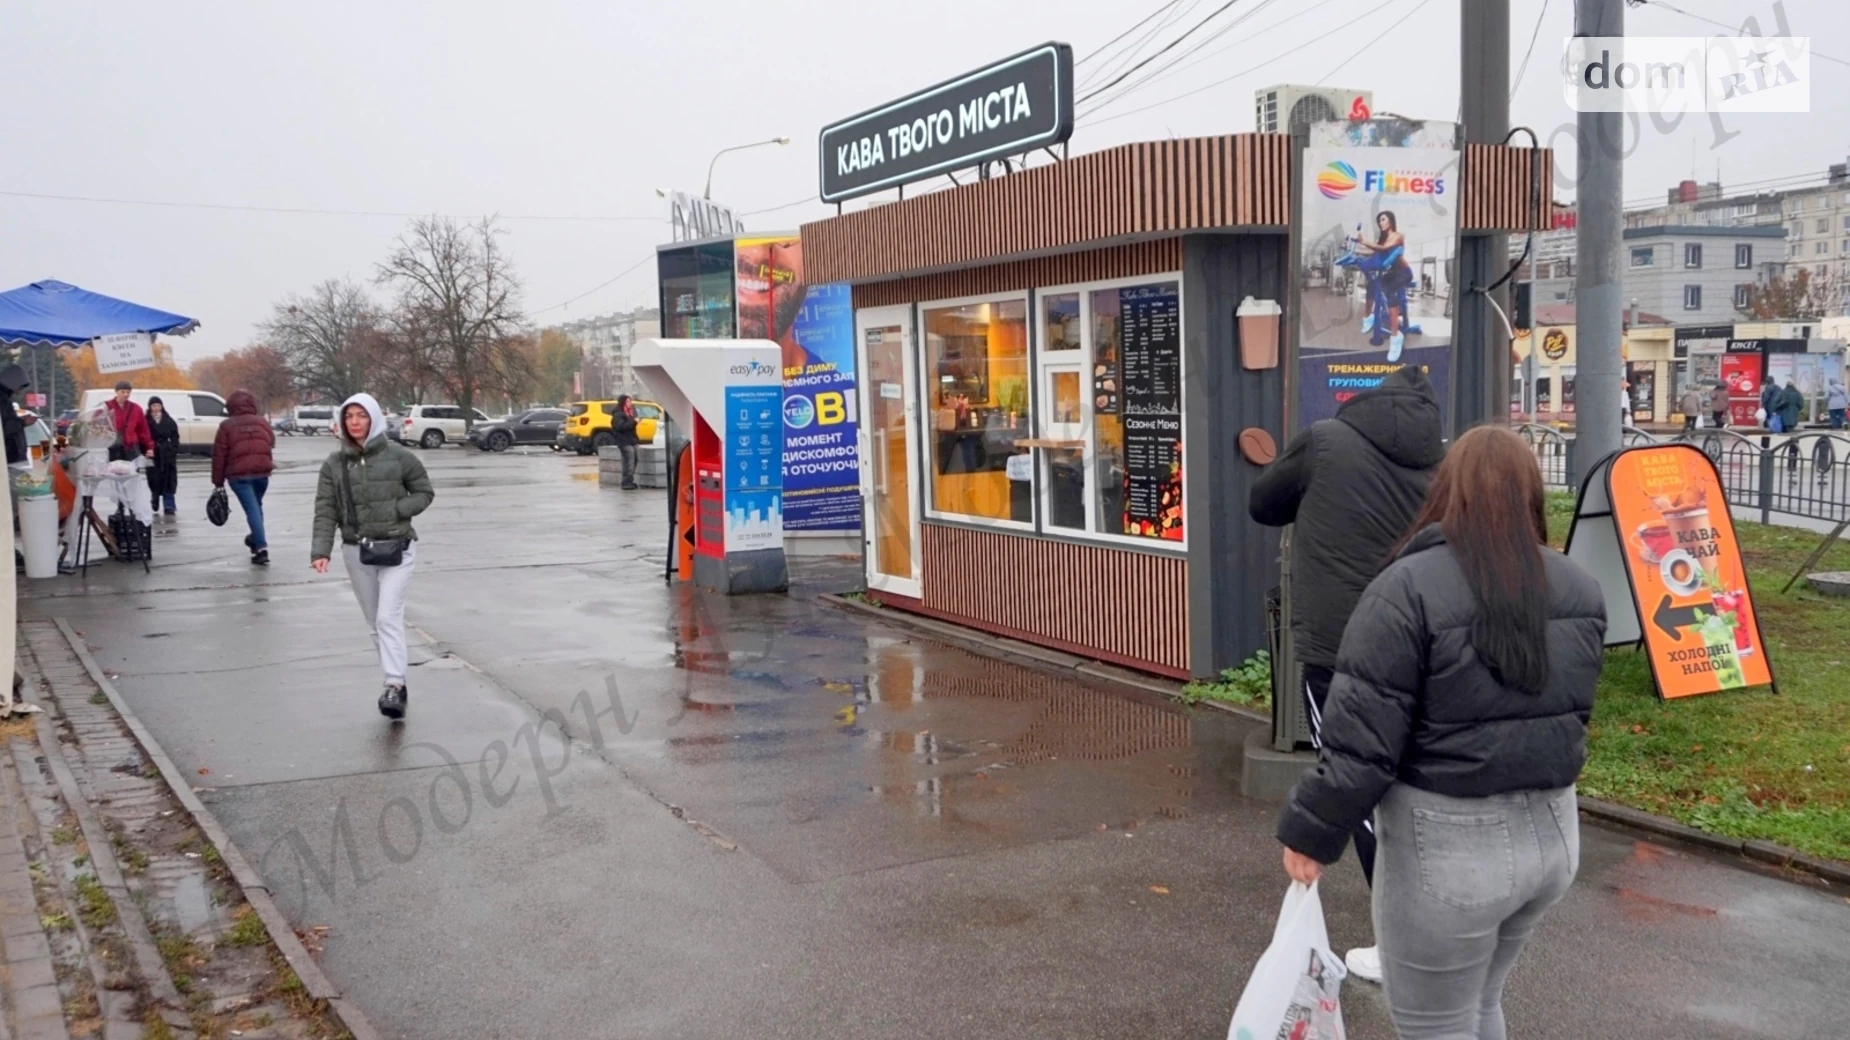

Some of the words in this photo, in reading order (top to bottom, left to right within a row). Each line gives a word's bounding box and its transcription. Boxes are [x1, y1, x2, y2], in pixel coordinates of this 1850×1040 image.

[837, 133, 885, 177] КАВА
[887, 108, 954, 160] ТВОГО
[958, 82, 1031, 139] МІСТА
[1364, 169, 1445, 195] Fitness
[784, 365, 803, 376] БЕЗ
[806, 362, 837, 375] ДИМУ
[1329, 377, 1385, 387] ГРУПОВИ
[786, 433, 842, 448] МОМЕНТ
[1676, 527, 1721, 544] КАВА
[1684, 541, 1721, 560] ЧАЙ
[1668, 643, 1731, 663] ХОЛОДНІ
[1681, 656, 1728, 675] НАПОЇ
